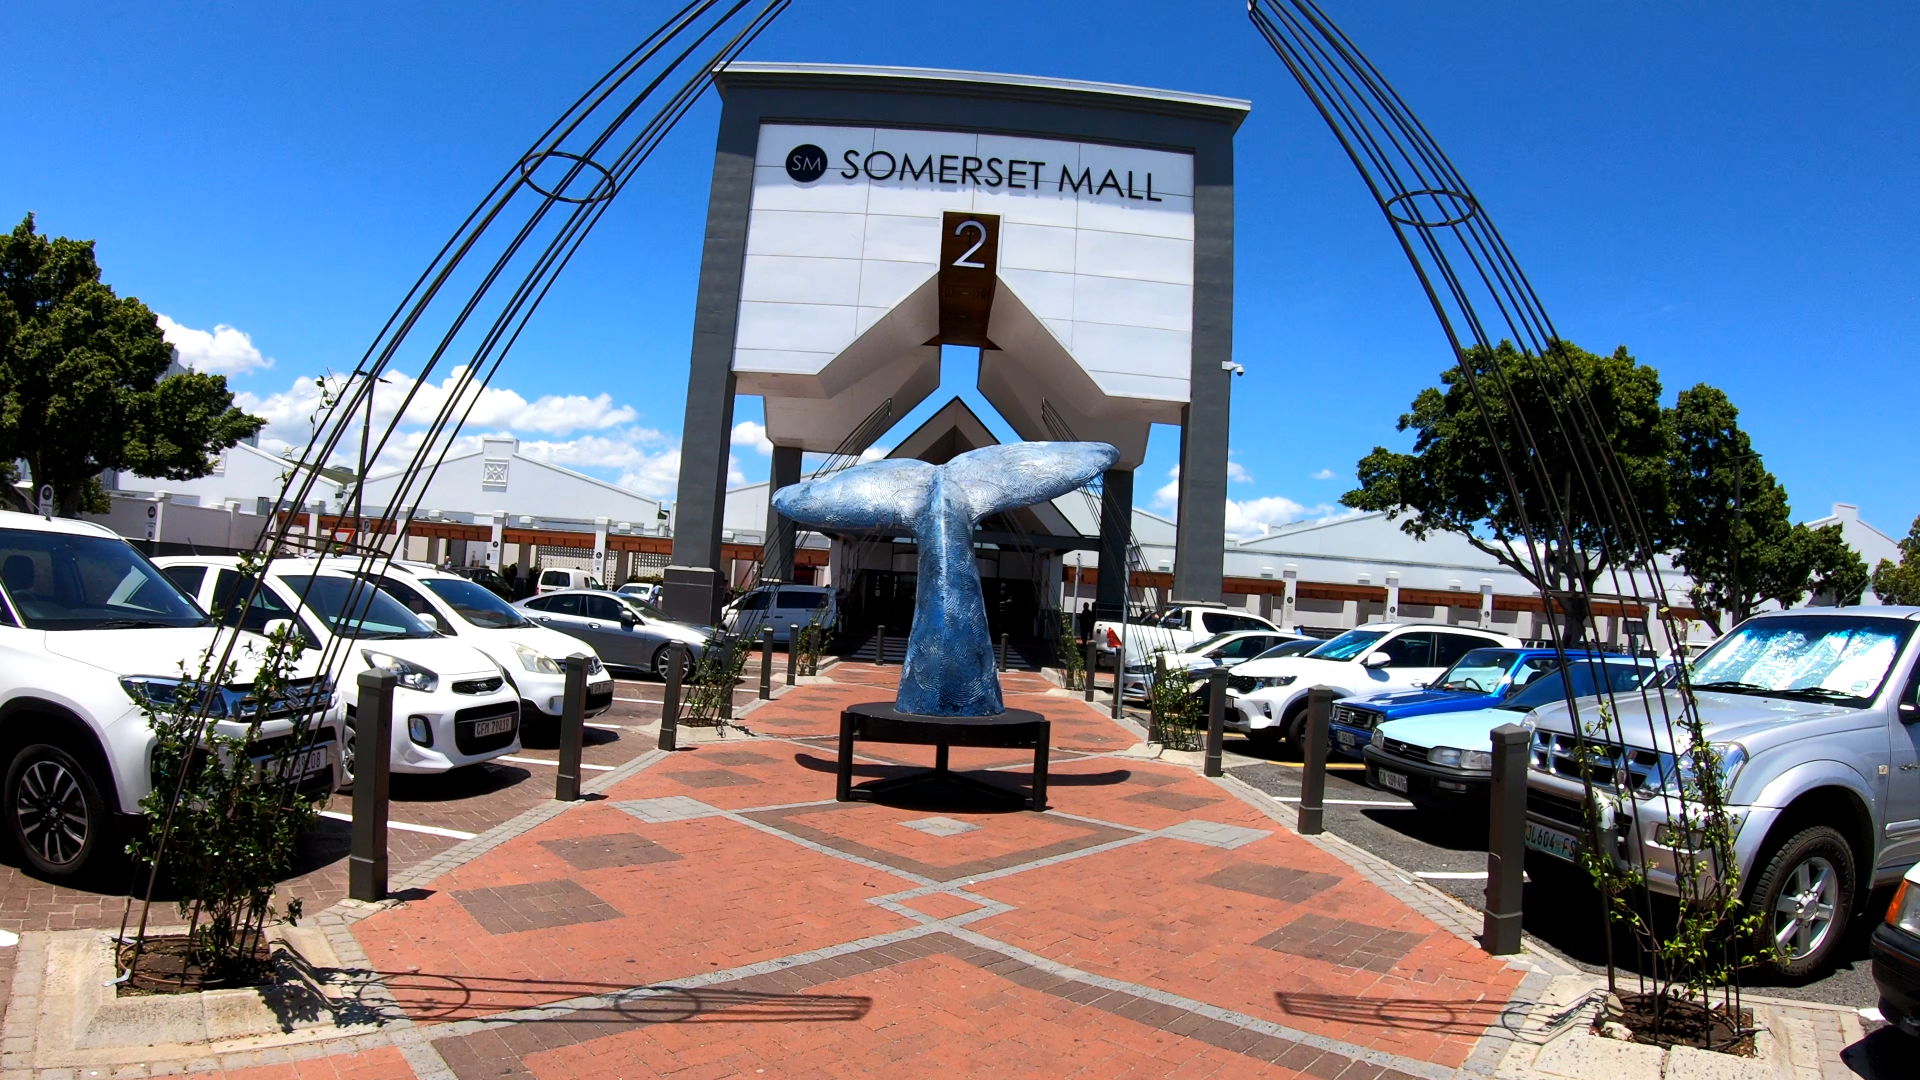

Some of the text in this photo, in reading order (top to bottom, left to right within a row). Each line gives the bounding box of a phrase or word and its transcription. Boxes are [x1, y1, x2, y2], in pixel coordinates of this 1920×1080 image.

[791, 154, 821, 172] SM
[840, 150, 1162, 202] SOMERSET MALL
[952, 220, 987, 269] 2
[1561, 837, 1577, 858] FS
